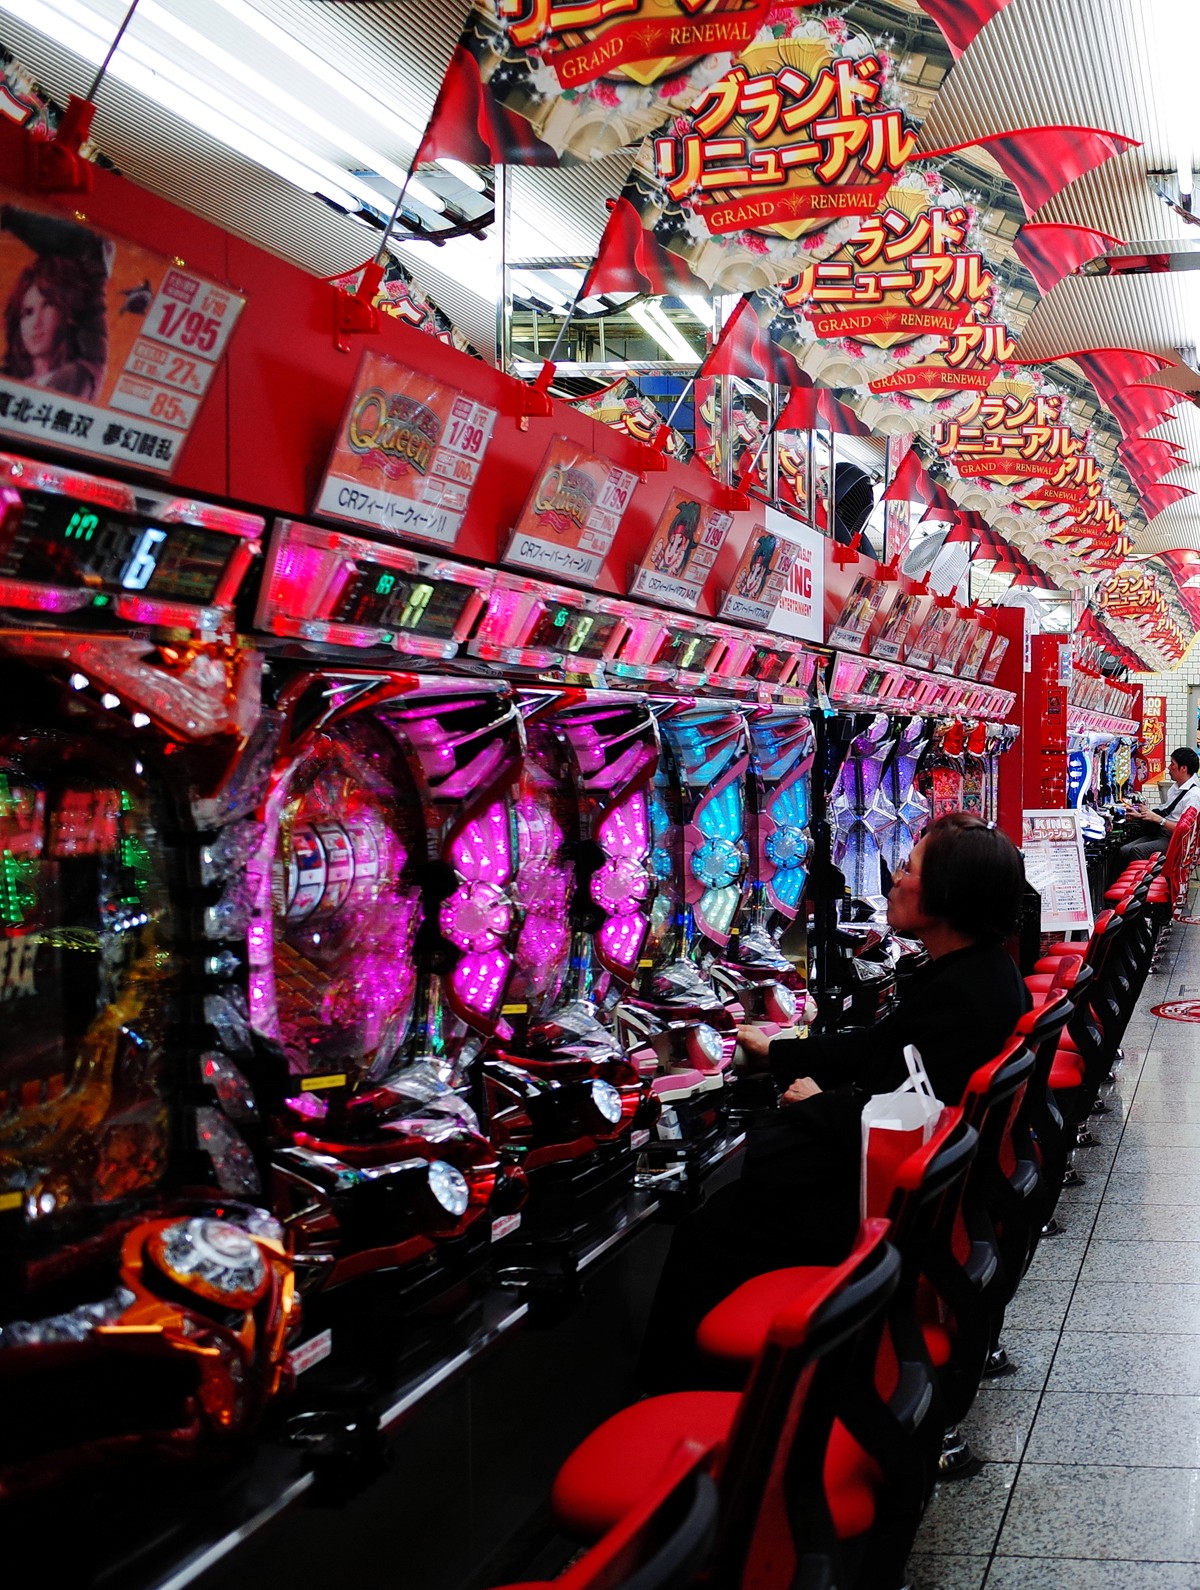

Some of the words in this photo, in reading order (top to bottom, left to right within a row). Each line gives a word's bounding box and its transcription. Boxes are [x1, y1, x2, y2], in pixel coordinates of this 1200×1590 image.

[561, 36, 625, 80] GRAND
[669, 21, 751, 46] RENEWAL
[690, 53, 881, 141] グランド
[654, 109, 918, 202] リニューアル
[710, 202, 775, 228] GRAND
[810, 193, 877, 210] RENEWAL
[157, 302, 221, 352] 1/95
[817, 316, 872, 333] GRAND
[900, 313, 955, 330] RENEWAL
[940, 373, 988, 387] RENEWAL
[348, 387, 431, 470] Queen
[449, 421, 484, 454] 1/99
[931, 423, 1076, 458] リニューアル
[960, 463, 997, 475] GRAND
[1015, 463, 1054, 476] RENEWAL
[601, 485, 628, 510] 1/99
[1043, 488, 1079, 502] RENEWAL
[704, 526, 723, 547] 1/99
[1104, 576, 1155, 595] グランド
[1096, 589, 1163, 610] リニューアル
[1033, 828, 1075, 840] コレクション
[1034, 817, 1072, 830] KING
